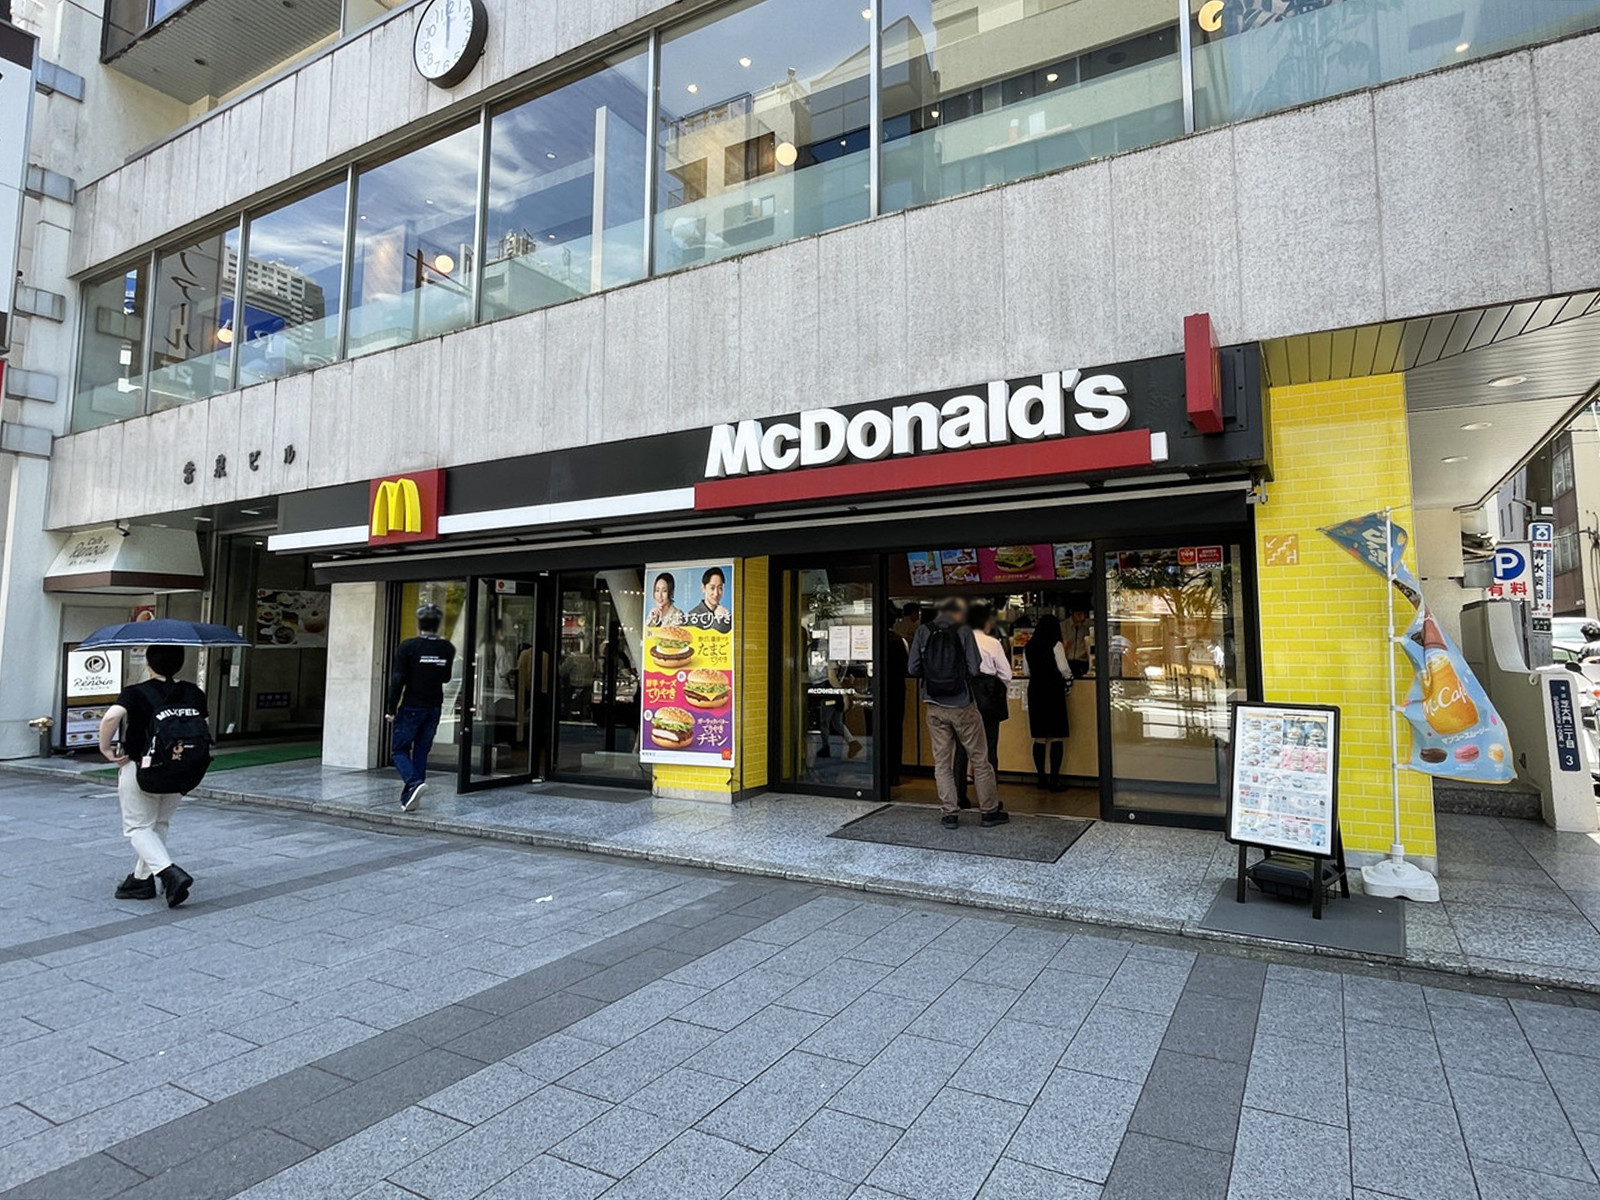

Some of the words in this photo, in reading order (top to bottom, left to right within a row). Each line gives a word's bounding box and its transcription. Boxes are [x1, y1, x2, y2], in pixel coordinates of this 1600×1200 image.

[434, 8, 444, 23] 11
[463, 6, 471, 20] 2
[425, 24, 437, 39] 10
[423, 41, 431, 54] 9
[426, 52, 434, 66] 8
[433, 60, 441, 74] 7
[704, 367, 1131, 478] McDonald's
[1496, 552, 1519, 577] P
[1488, 581, 1527, 597] 有料
[697, 642, 730, 657] たまご
[646, 687, 676, 703] てりやき
[696, 733, 729, 747] チキン
[1565, 754, 1574, 766] 3
